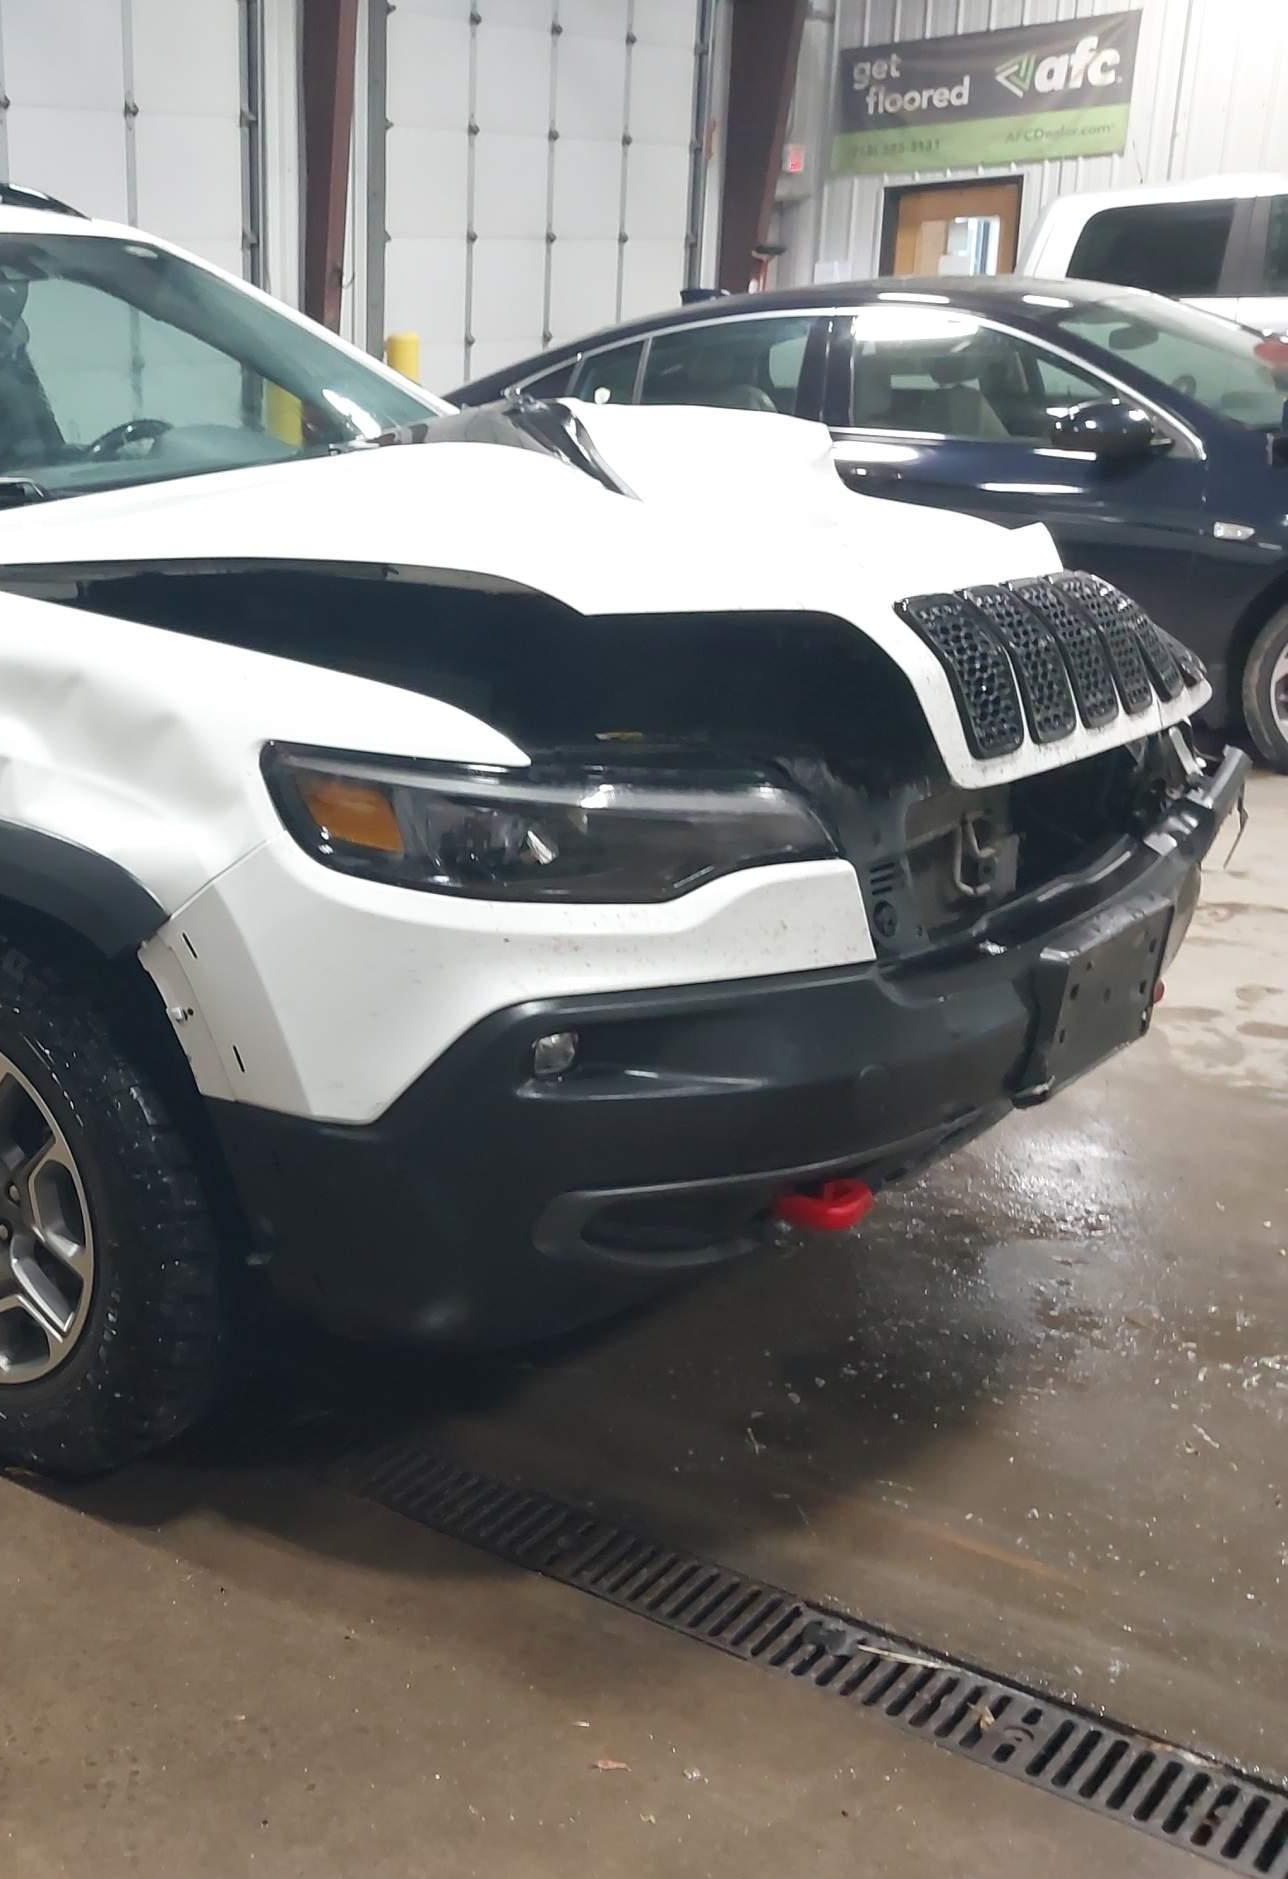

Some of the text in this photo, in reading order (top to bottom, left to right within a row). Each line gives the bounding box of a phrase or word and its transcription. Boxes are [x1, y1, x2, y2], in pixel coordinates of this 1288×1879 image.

[853, 53, 902, 90] get
[1034, 35, 1121, 93] afc
[865, 75, 971, 115] floored
